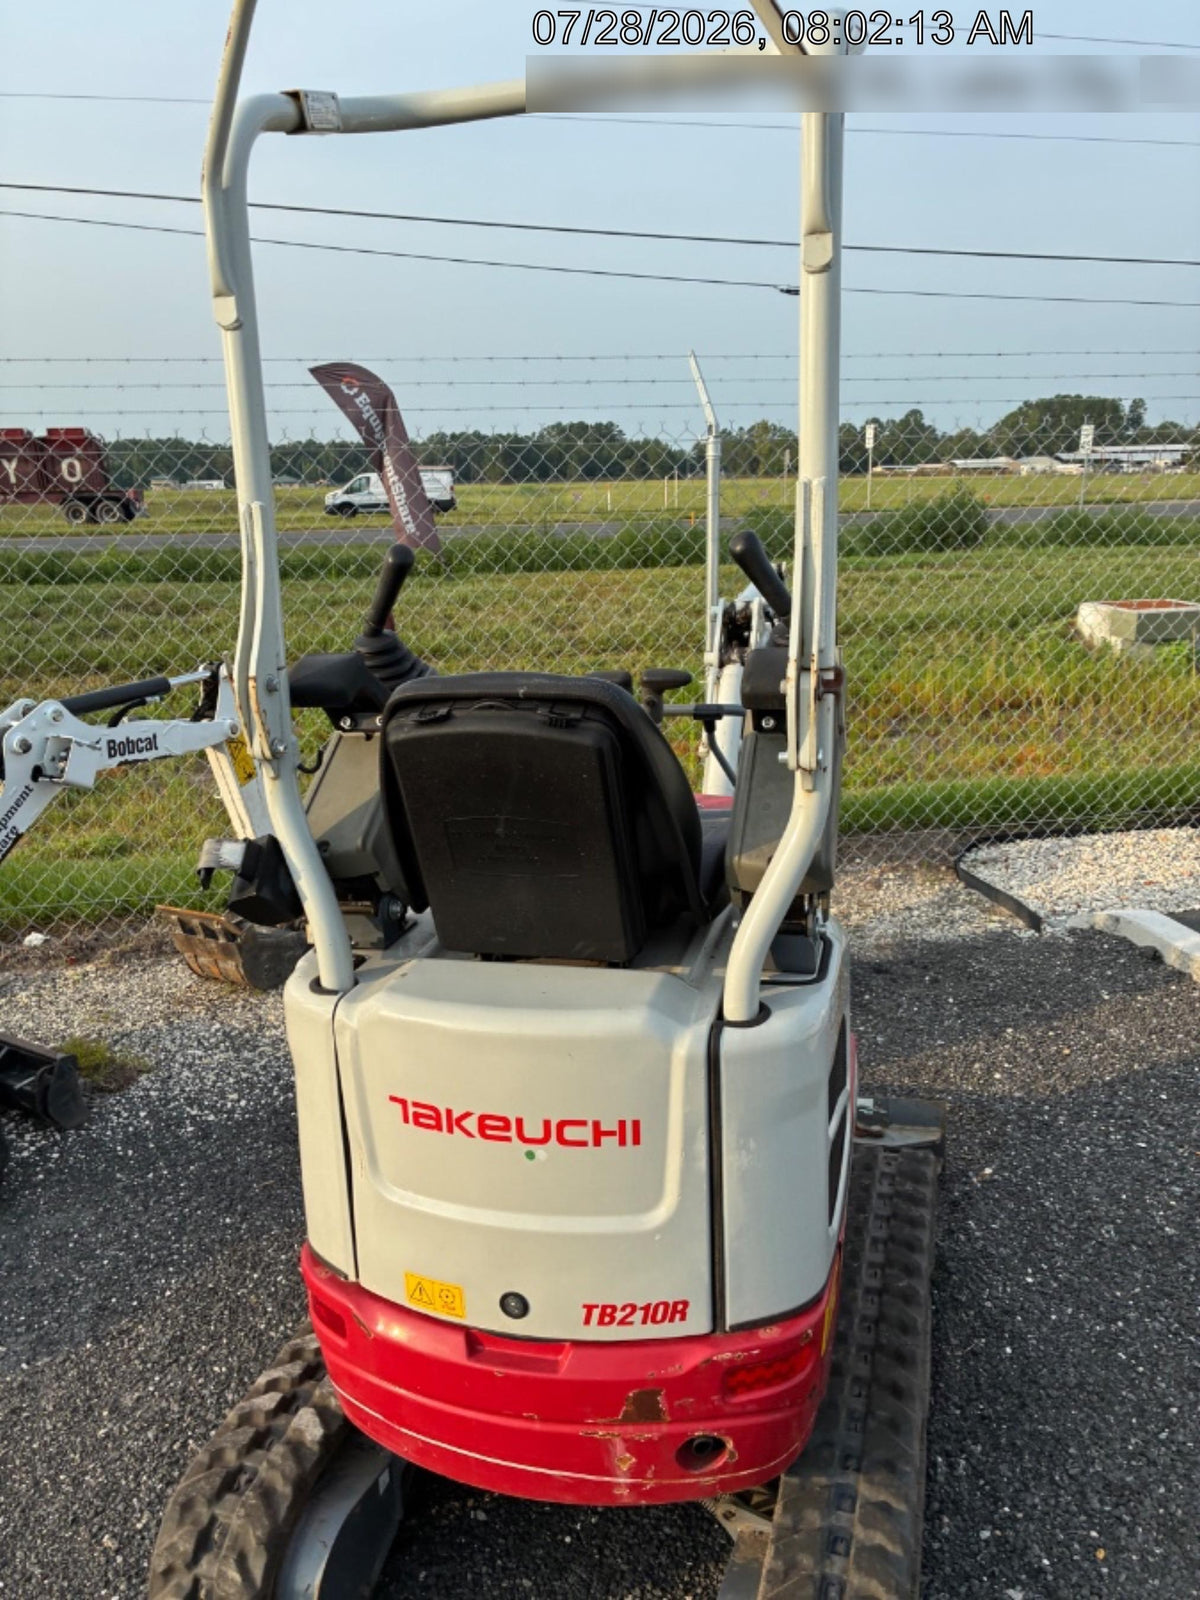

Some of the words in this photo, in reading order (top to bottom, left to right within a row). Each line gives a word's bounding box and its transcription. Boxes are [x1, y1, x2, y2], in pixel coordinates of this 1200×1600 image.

[107, 733, 159, 759] Bobcat
[0, 784, 34, 832] pment
[582, 1300, 690, 1326] TB210R
